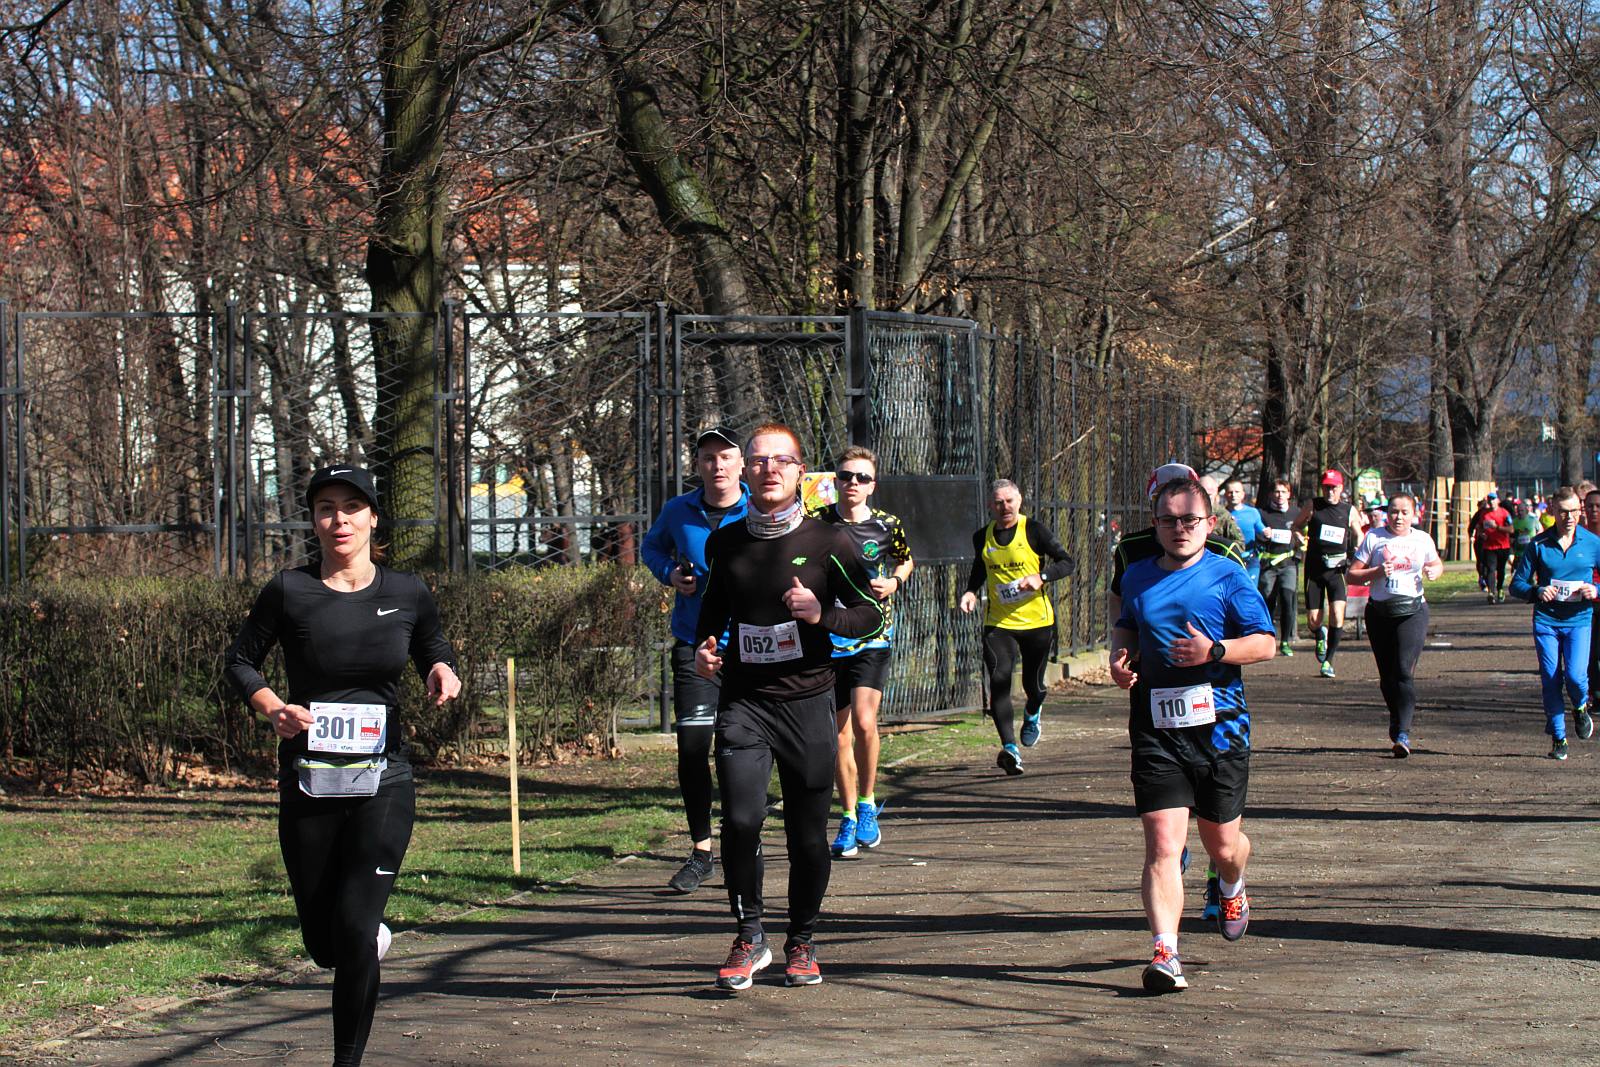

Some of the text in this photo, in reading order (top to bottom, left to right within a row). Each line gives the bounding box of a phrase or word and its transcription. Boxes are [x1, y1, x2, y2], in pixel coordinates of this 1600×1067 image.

[792, 557, 806, 566] 4F
[1385, 577, 1399, 588] 211
[743, 635, 775, 655] 052
[1158, 698, 1187, 719] 110
[316, 715, 355, 740] 301
